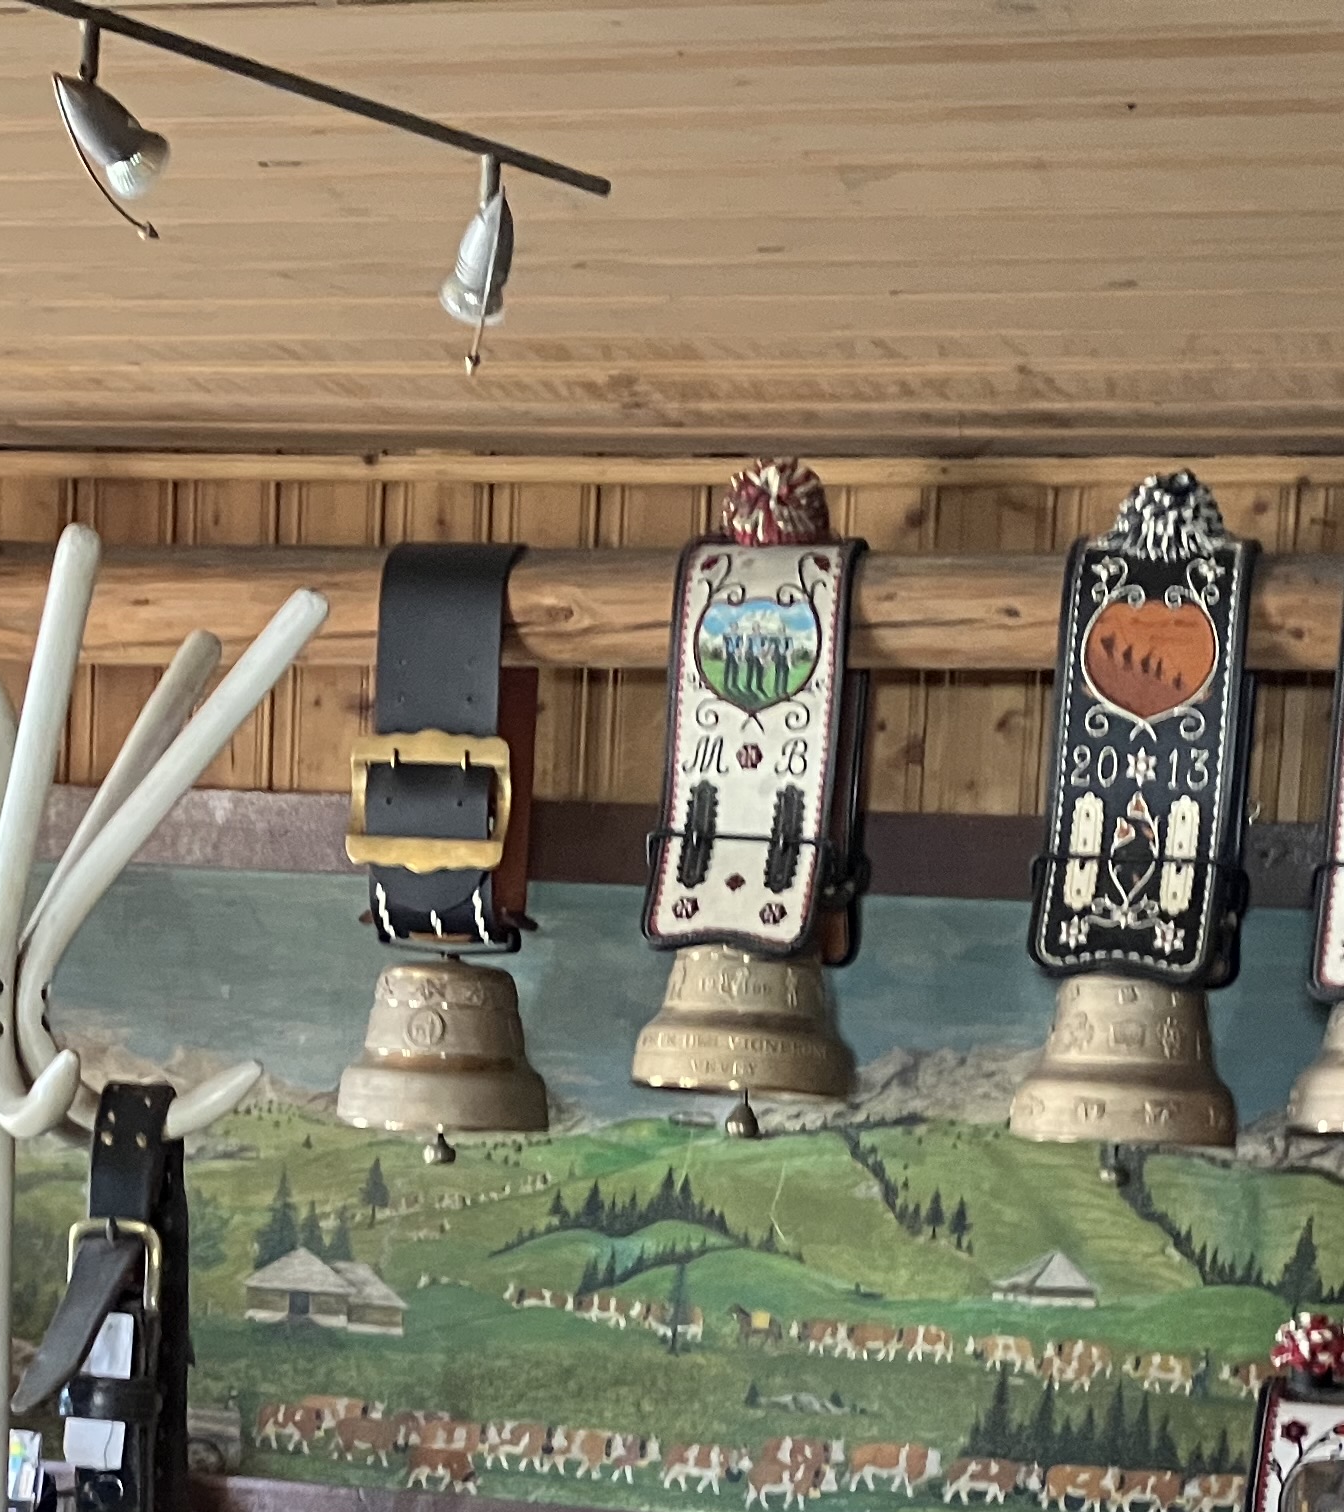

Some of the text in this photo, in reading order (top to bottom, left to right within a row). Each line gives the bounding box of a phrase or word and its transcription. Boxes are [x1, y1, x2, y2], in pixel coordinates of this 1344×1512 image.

[682, 735, 809, 776] M B
[1070, 743, 1210, 792] 20 13
